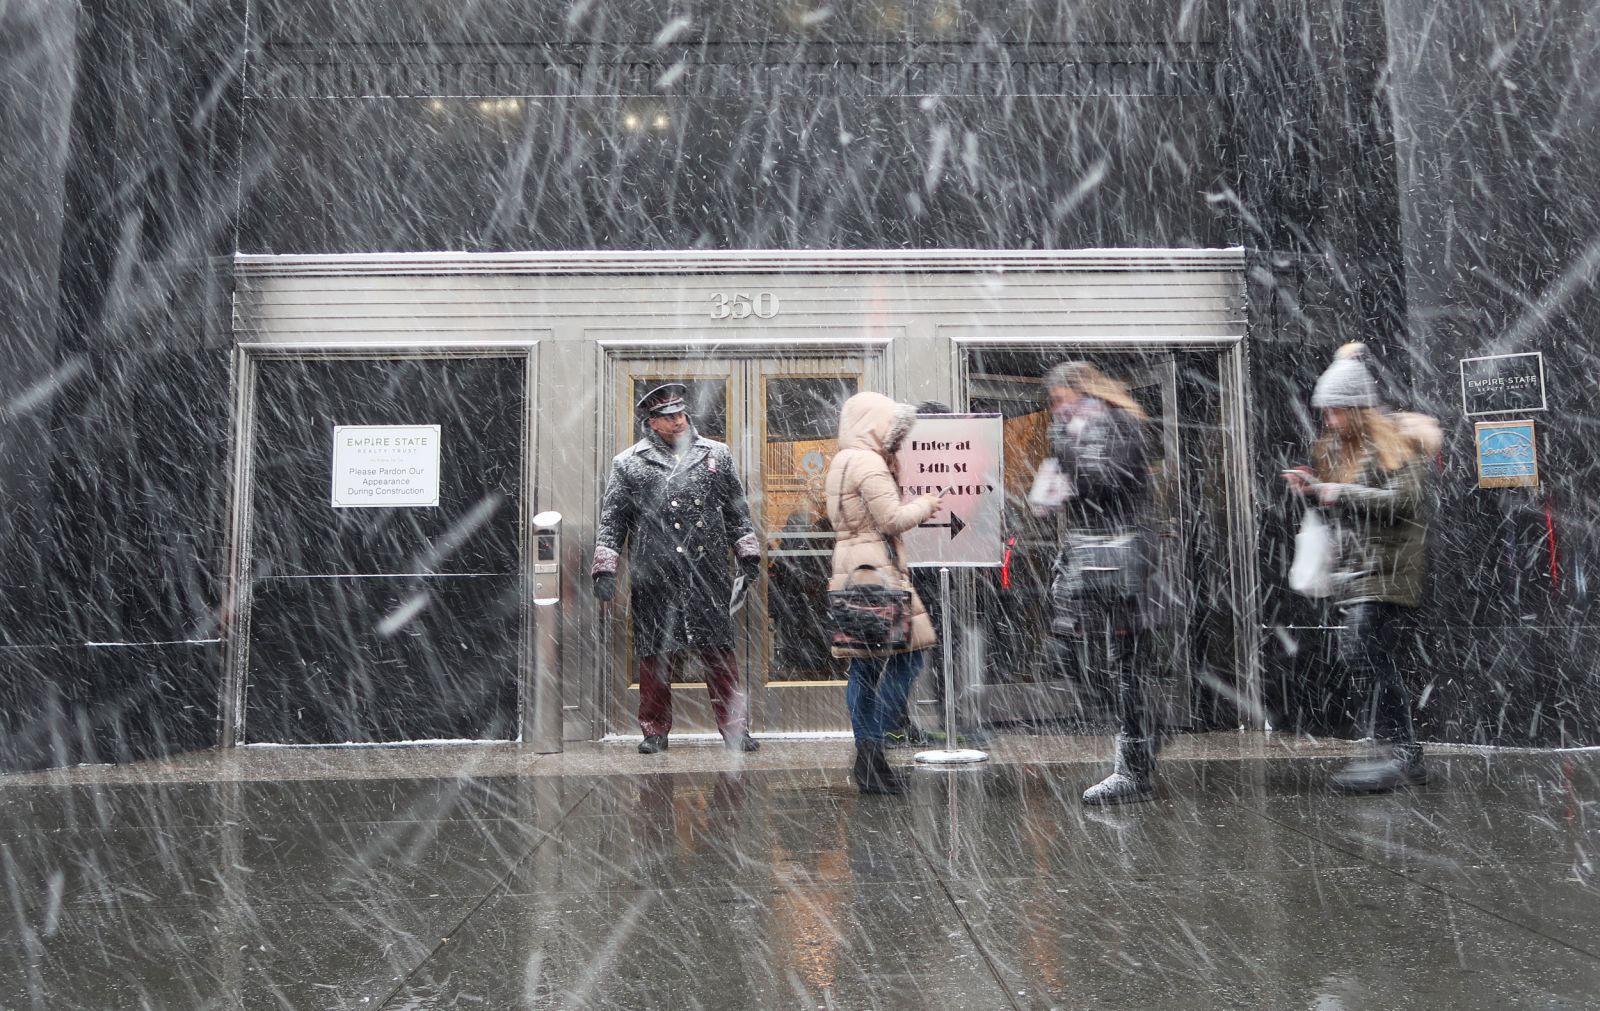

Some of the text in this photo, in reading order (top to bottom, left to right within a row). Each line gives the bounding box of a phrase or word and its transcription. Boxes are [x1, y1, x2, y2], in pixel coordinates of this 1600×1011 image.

[710, 292, 780, 319] 350
[1468, 375, 1537, 388] EMPIRE STATE
[347, 437, 428, 447] EMPIRE STATE
[912, 440, 971, 450] Enter at
[916, 462, 968, 473] 34th St
[347, 488, 374, 496] During
[898, 484, 994, 496] BSERVATORY
